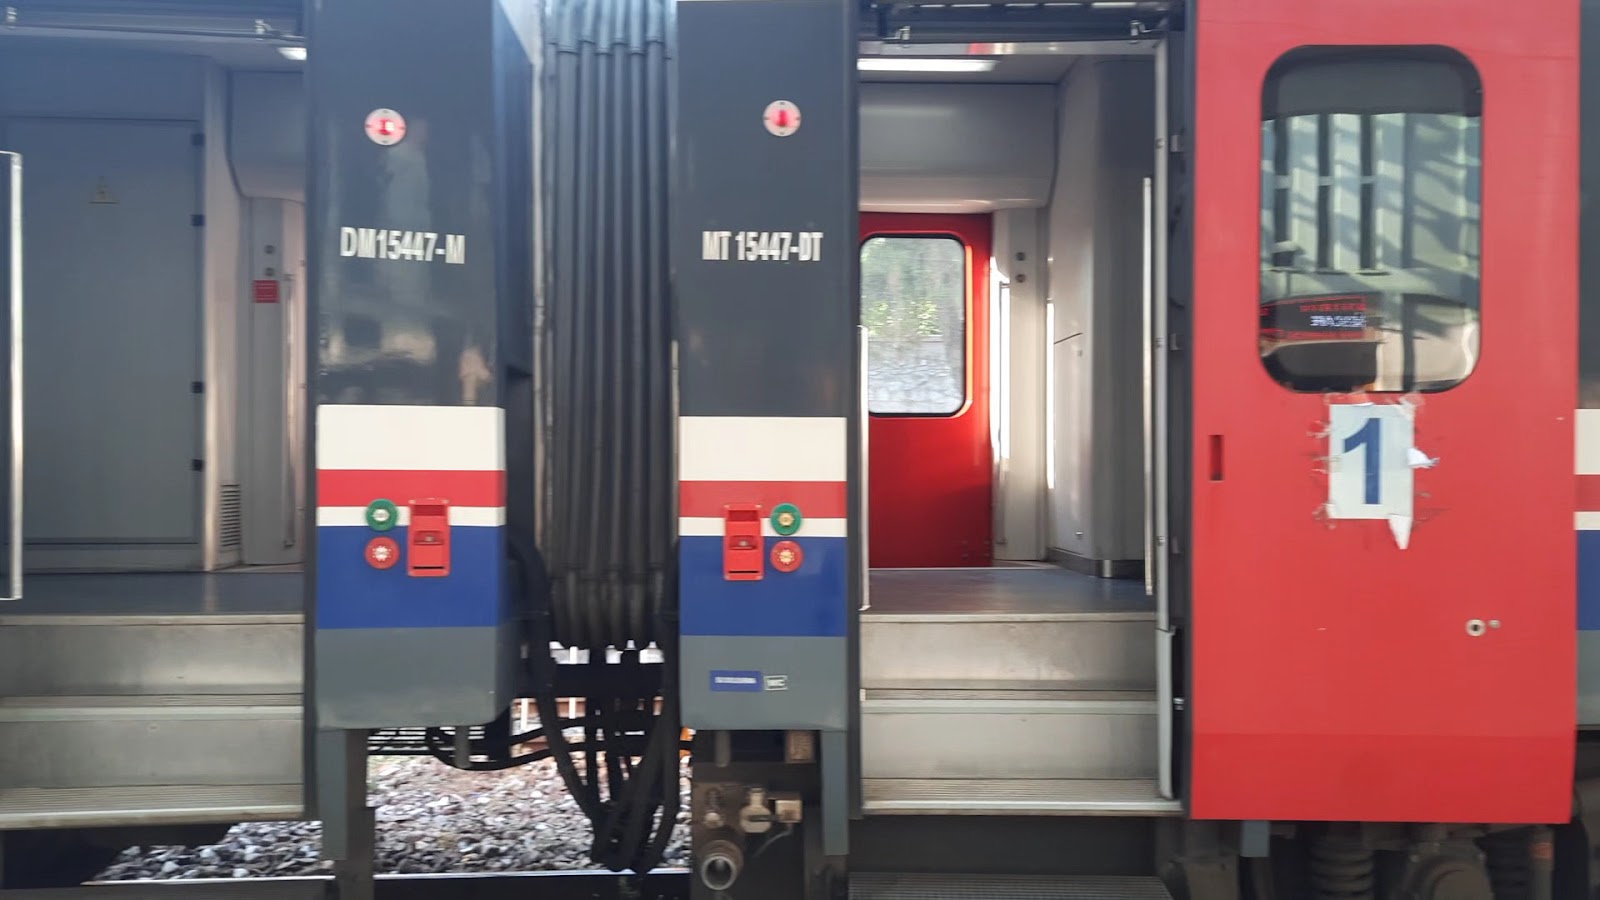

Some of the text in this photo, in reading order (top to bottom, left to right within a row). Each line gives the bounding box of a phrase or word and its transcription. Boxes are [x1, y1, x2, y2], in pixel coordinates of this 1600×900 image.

[702, 231, 824, 261] MT 15447-DT
[1342, 417, 1382, 505] 1
